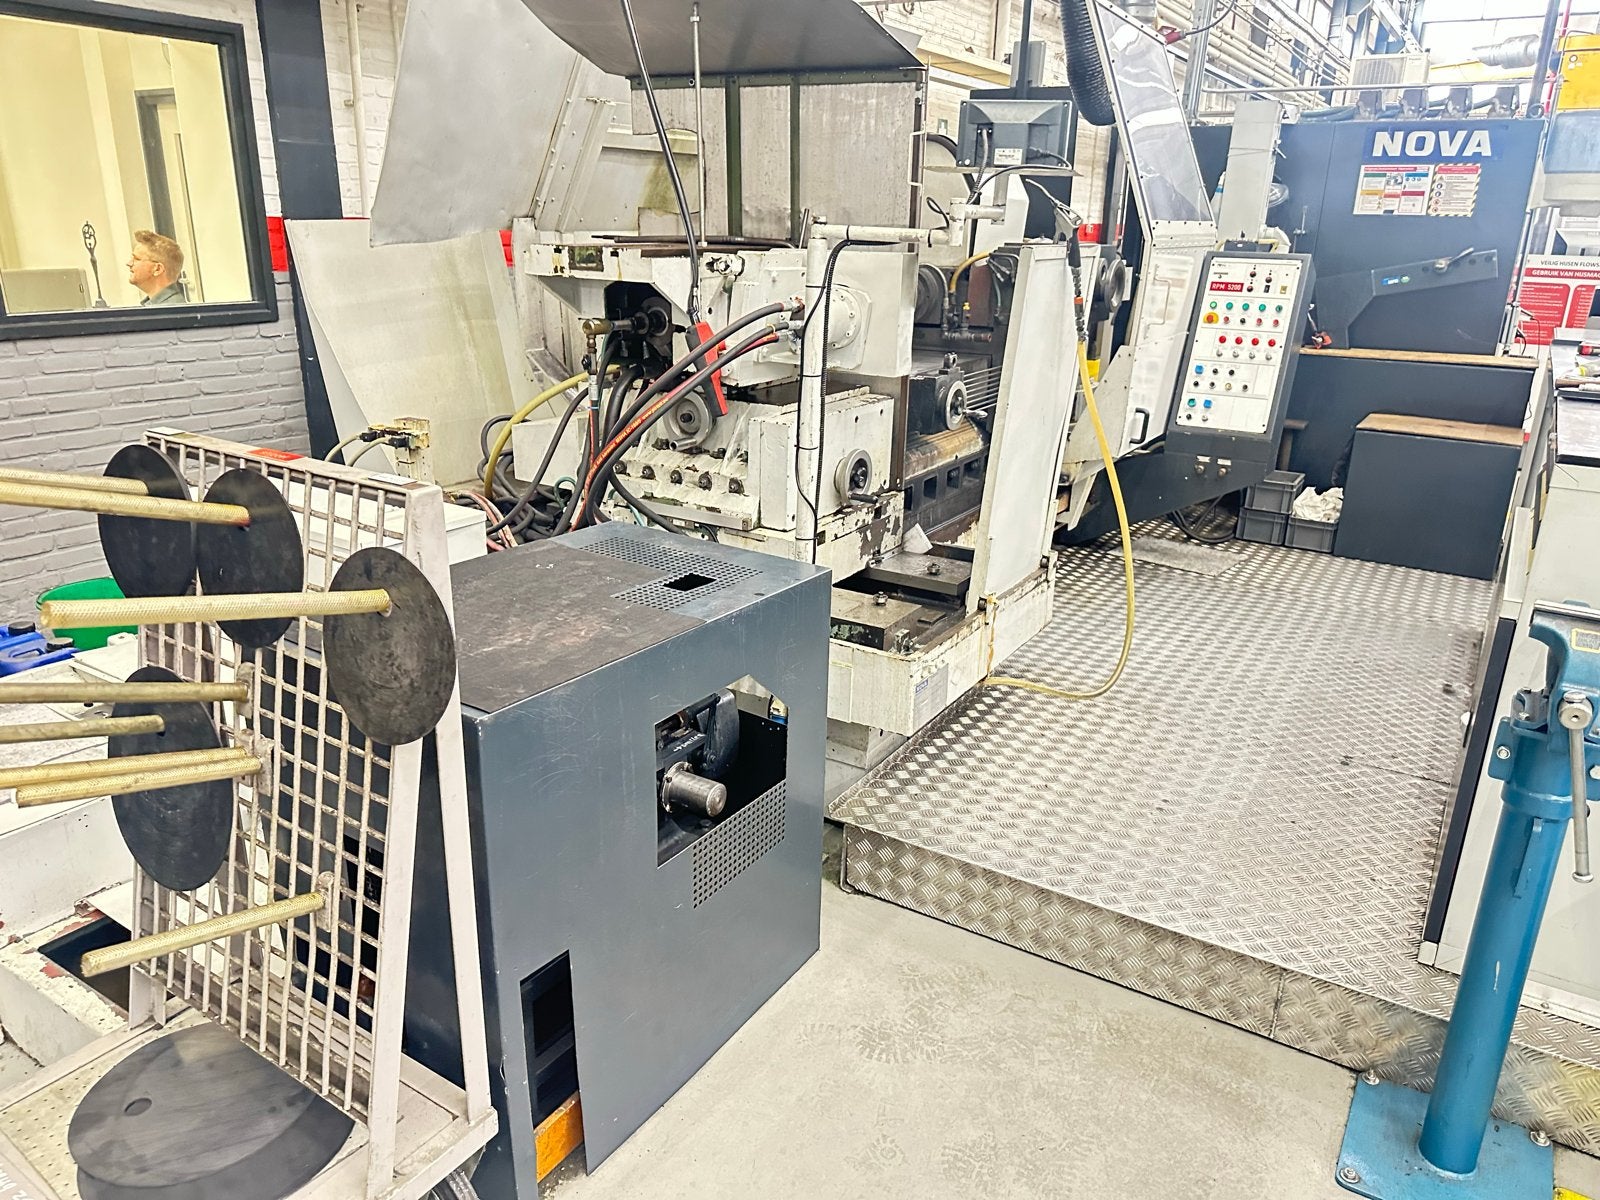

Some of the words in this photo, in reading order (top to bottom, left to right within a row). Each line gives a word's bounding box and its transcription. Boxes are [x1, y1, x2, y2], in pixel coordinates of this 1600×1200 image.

[1372, 130, 1492, 157] NOVA
[1531, 269, 1559, 277] GEBRUIK
[1227, 283, 1242, 291] 5200
